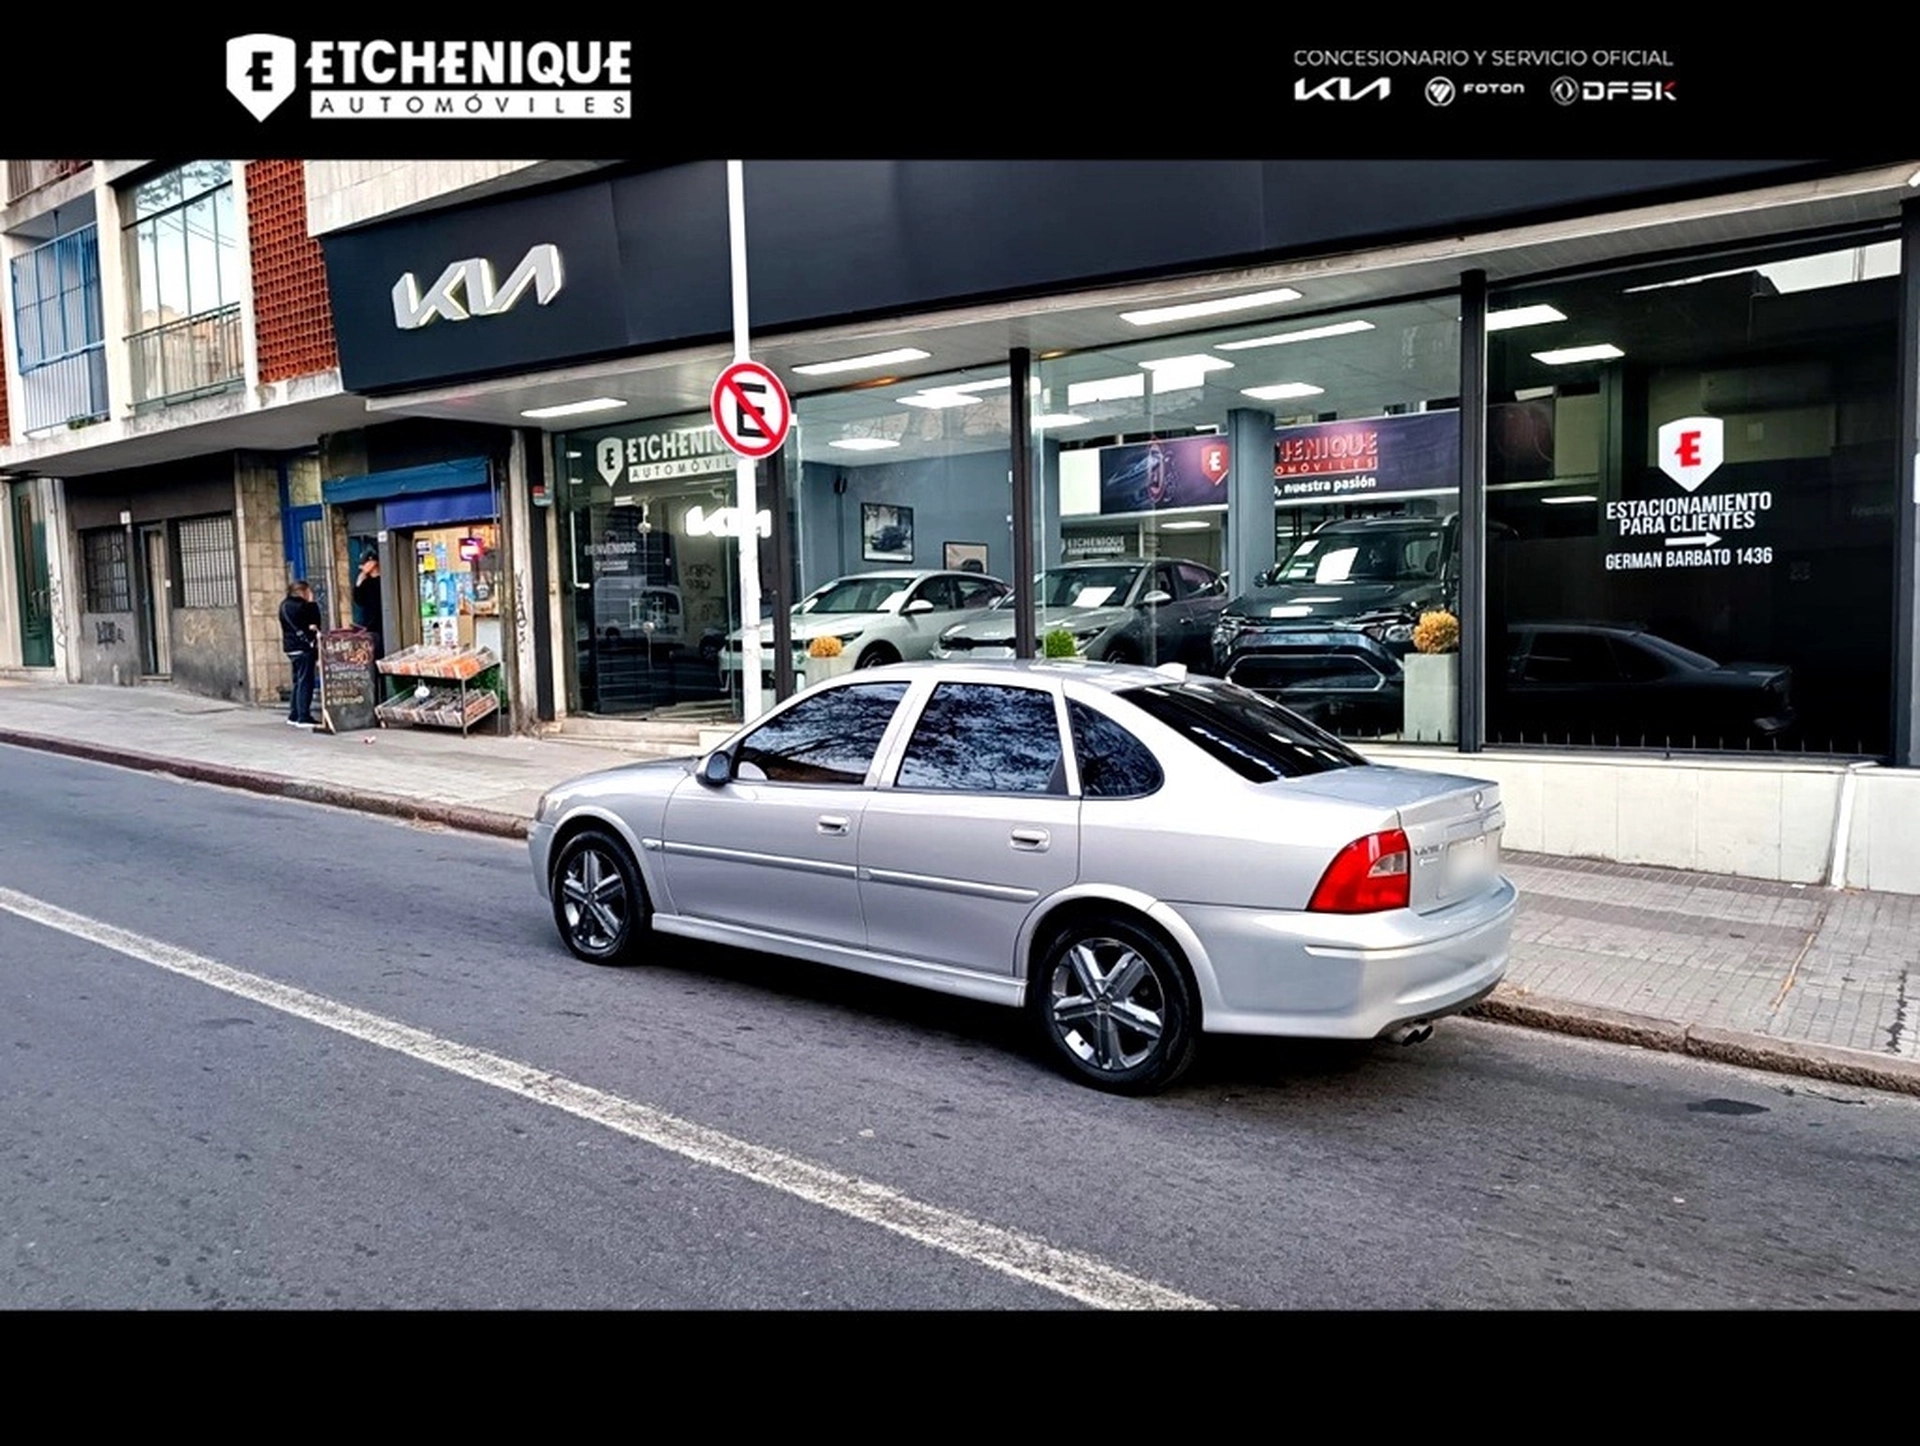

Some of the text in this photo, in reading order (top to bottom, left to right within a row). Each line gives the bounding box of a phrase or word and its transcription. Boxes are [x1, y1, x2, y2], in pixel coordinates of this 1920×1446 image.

[391, 243, 562, 330] KIA
[736, 382, 769, 438] E
[626, 431, 729, 464] ETCHENI
[1274, 431, 1378, 463] HENIQUE
[1674, 430, 1701, 468] E
[631, 458, 731, 479] AUTOMÓVIL
[1275, 457, 1373, 475] OMÓVILES
[1284, 480, 1332, 493] nuestra
[1334, 475, 1377, 493] pasión
[1606, 491, 1772, 519] ESTACIONAMIENTO
[1620, 511, 1755, 536] PARA CLIENTES
[1605, 547, 1773, 570] GERMAN BARBATO 1436
